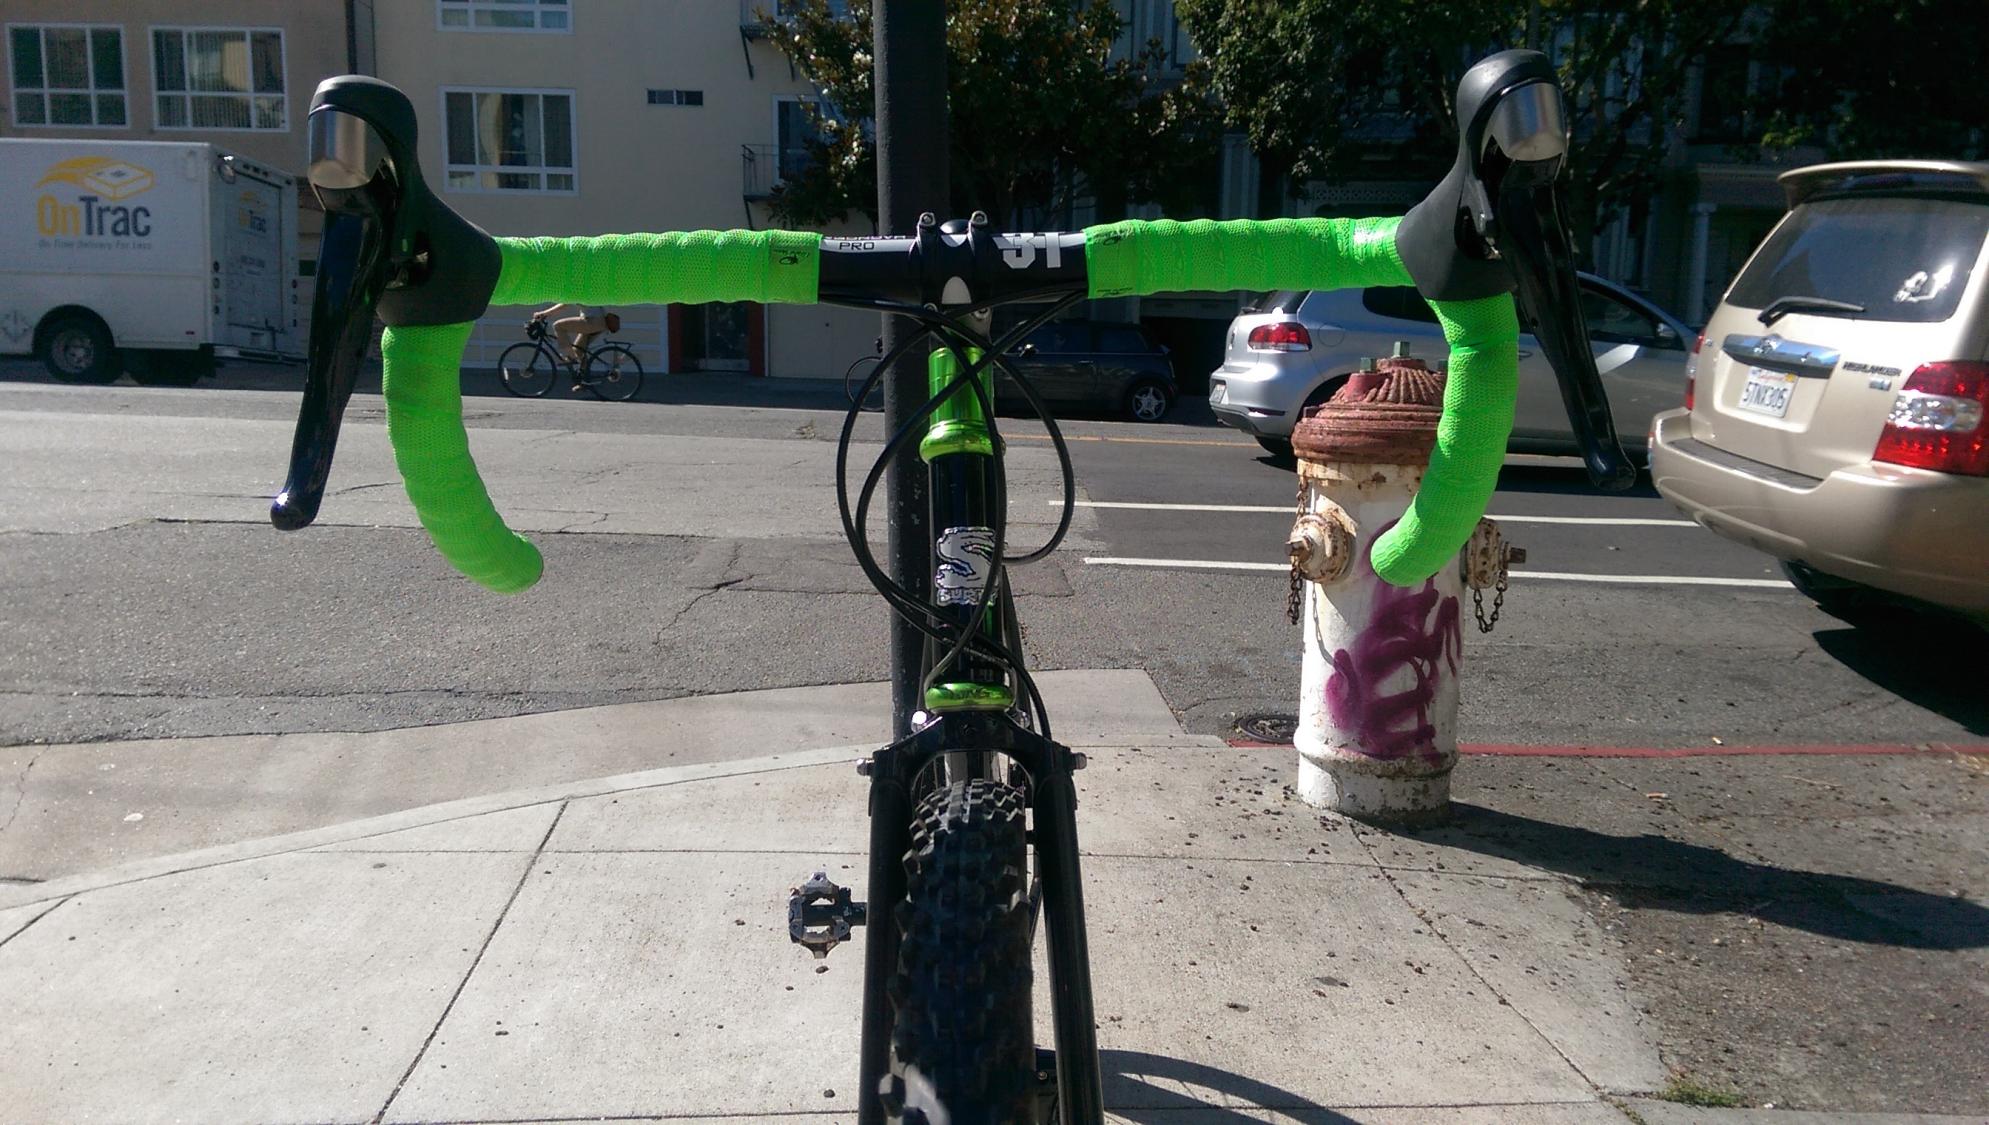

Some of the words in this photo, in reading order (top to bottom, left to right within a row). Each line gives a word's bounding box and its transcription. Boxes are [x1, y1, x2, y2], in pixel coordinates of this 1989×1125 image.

[37, 194, 151, 236] OnTrac
[839, 242, 875, 250] PRO
[1743, 381, 1787, 408] 5TNX305
